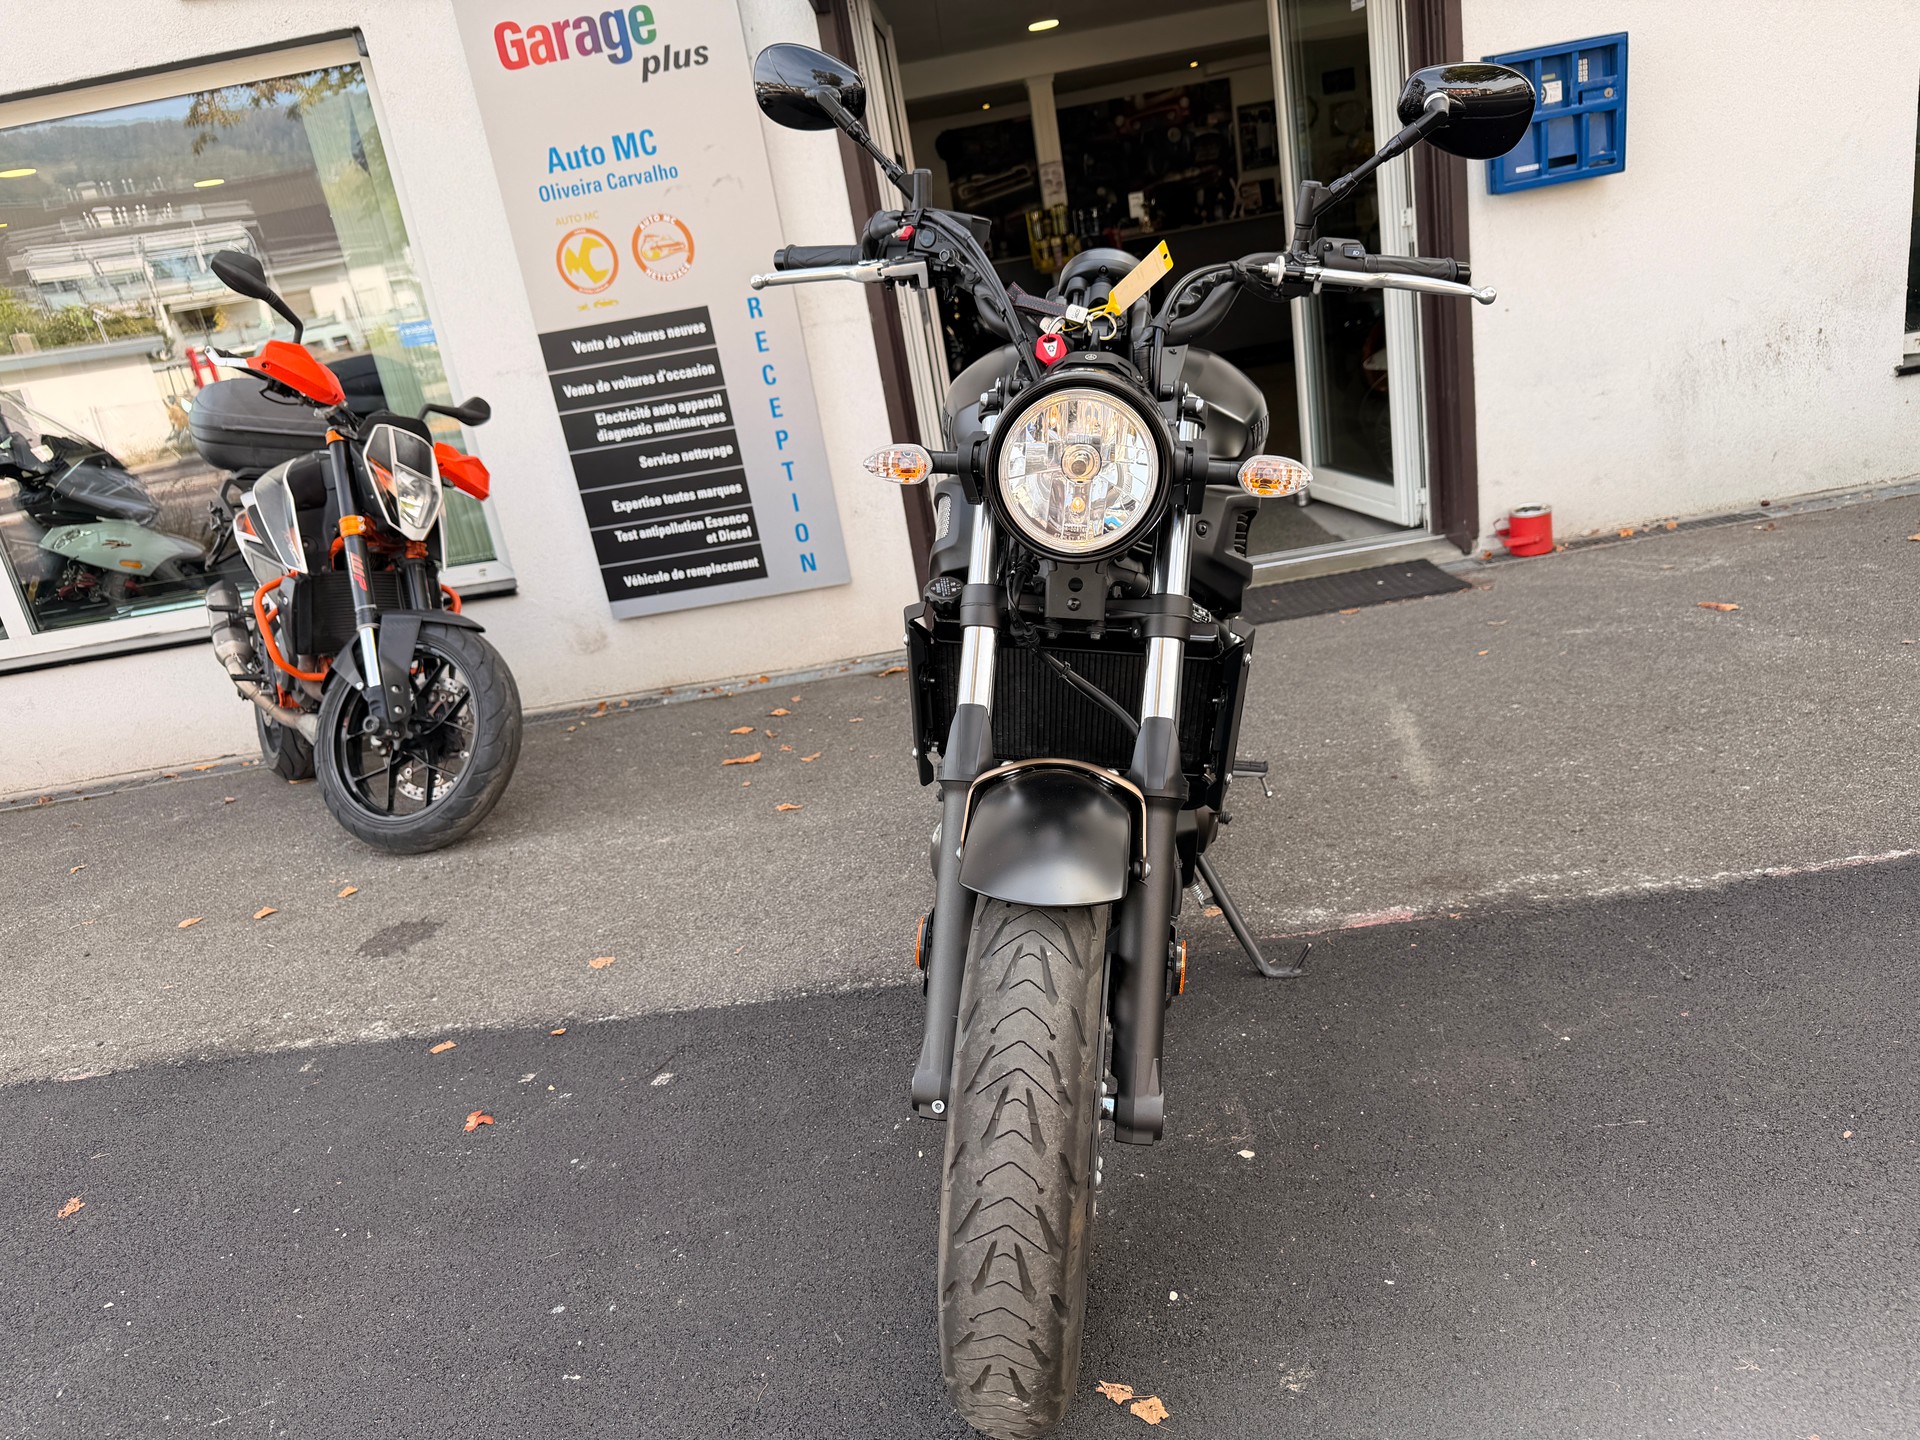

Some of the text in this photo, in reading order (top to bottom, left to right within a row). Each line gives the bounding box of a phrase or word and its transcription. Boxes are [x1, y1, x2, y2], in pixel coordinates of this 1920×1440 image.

[494, 4, 657, 70] Garage
[641, 45, 709, 83] plus
[548, 129, 657, 174] Auto MC
[539, 164, 679, 203] Oliveira Carvalho
[555, 211, 599, 226] AUTO MC
[639, 214, 677, 230] AUTO MC
[571, 321, 707, 354] Vente de voitures neuves
[562, 362, 716, 398] Vente de voitures d'occasion
[594, 393, 723, 426] Electricité auto appareil
[596, 411, 727, 442] diagnostic multimarques
[638, 444, 734, 468] Service nettoyage
[611, 483, 743, 513] Expertise toutes marques
[614, 513, 749, 543] Test antipollution Essence
[706, 526, 753, 544] et Diesel
[623, 556, 760, 588] Véhicule de remplacement
